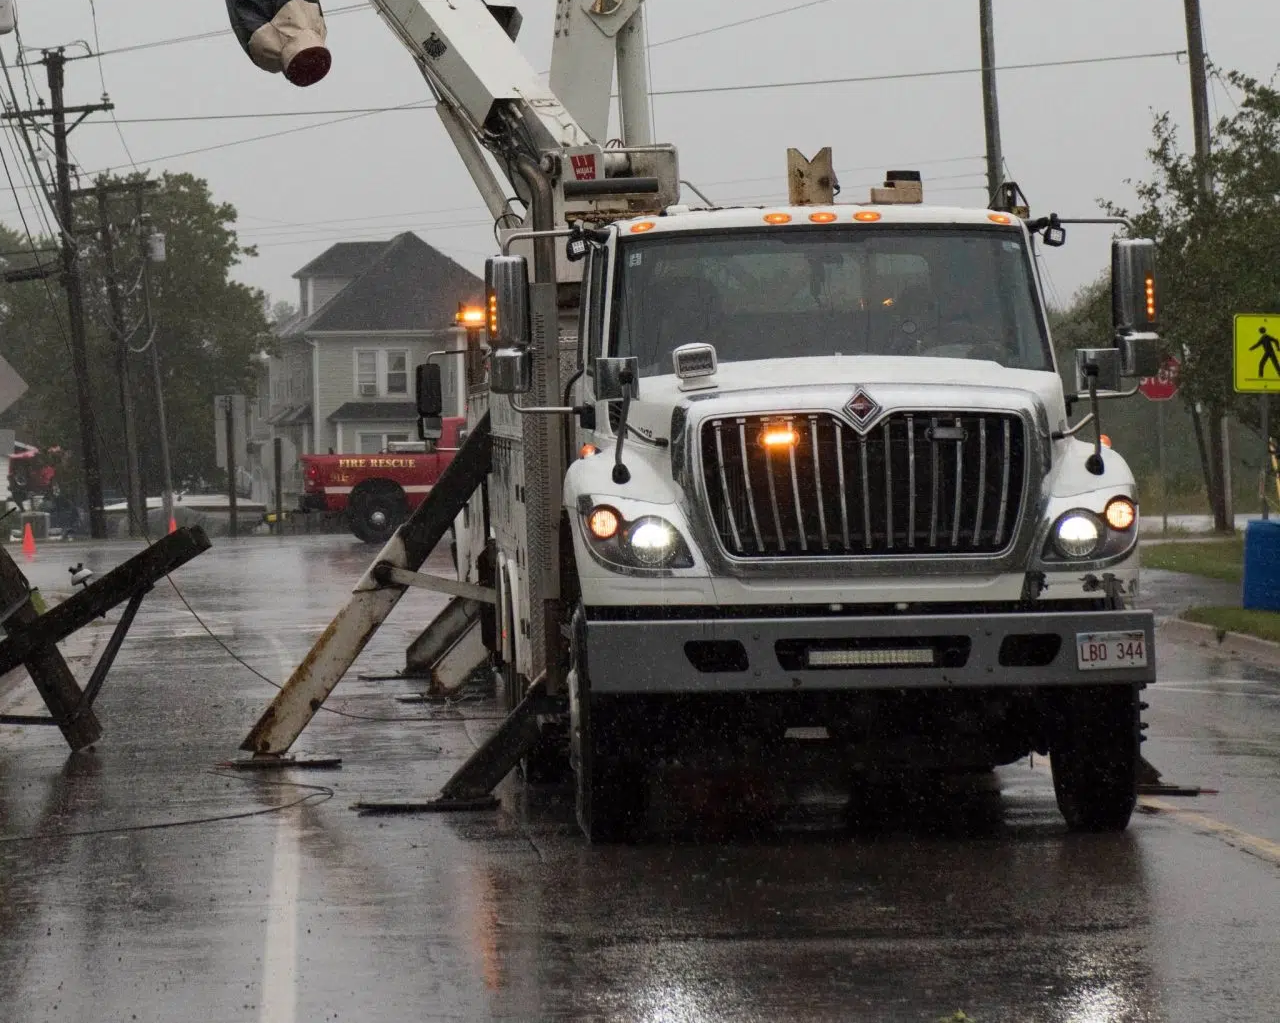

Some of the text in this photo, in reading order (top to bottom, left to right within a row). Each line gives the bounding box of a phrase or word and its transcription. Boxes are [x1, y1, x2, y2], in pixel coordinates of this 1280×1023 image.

[339, 458, 416, 468] FIRE RESCUE
[1116, 641, 1144, 660] 344
